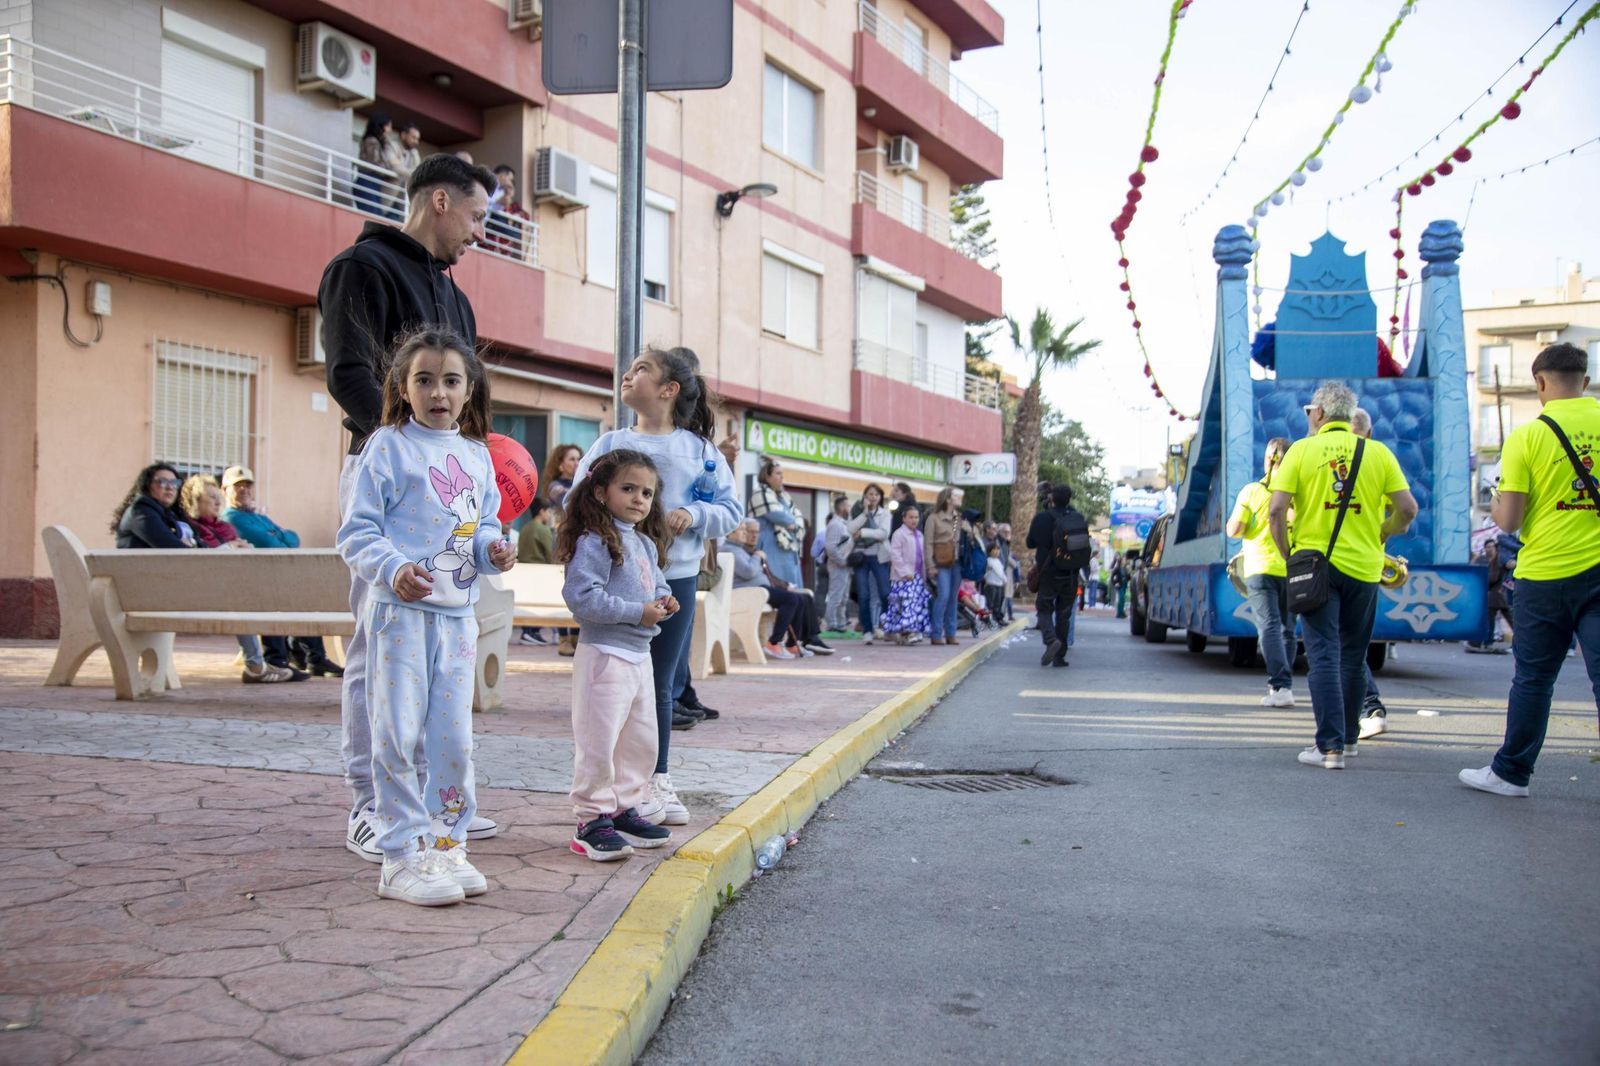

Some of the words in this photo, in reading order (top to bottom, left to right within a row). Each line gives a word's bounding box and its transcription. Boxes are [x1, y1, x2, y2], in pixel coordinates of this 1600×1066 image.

[768, 428, 817, 455] CENTRO
[820, 437, 863, 464] OPTICO
[865, 451, 932, 476] FARMAVISION
